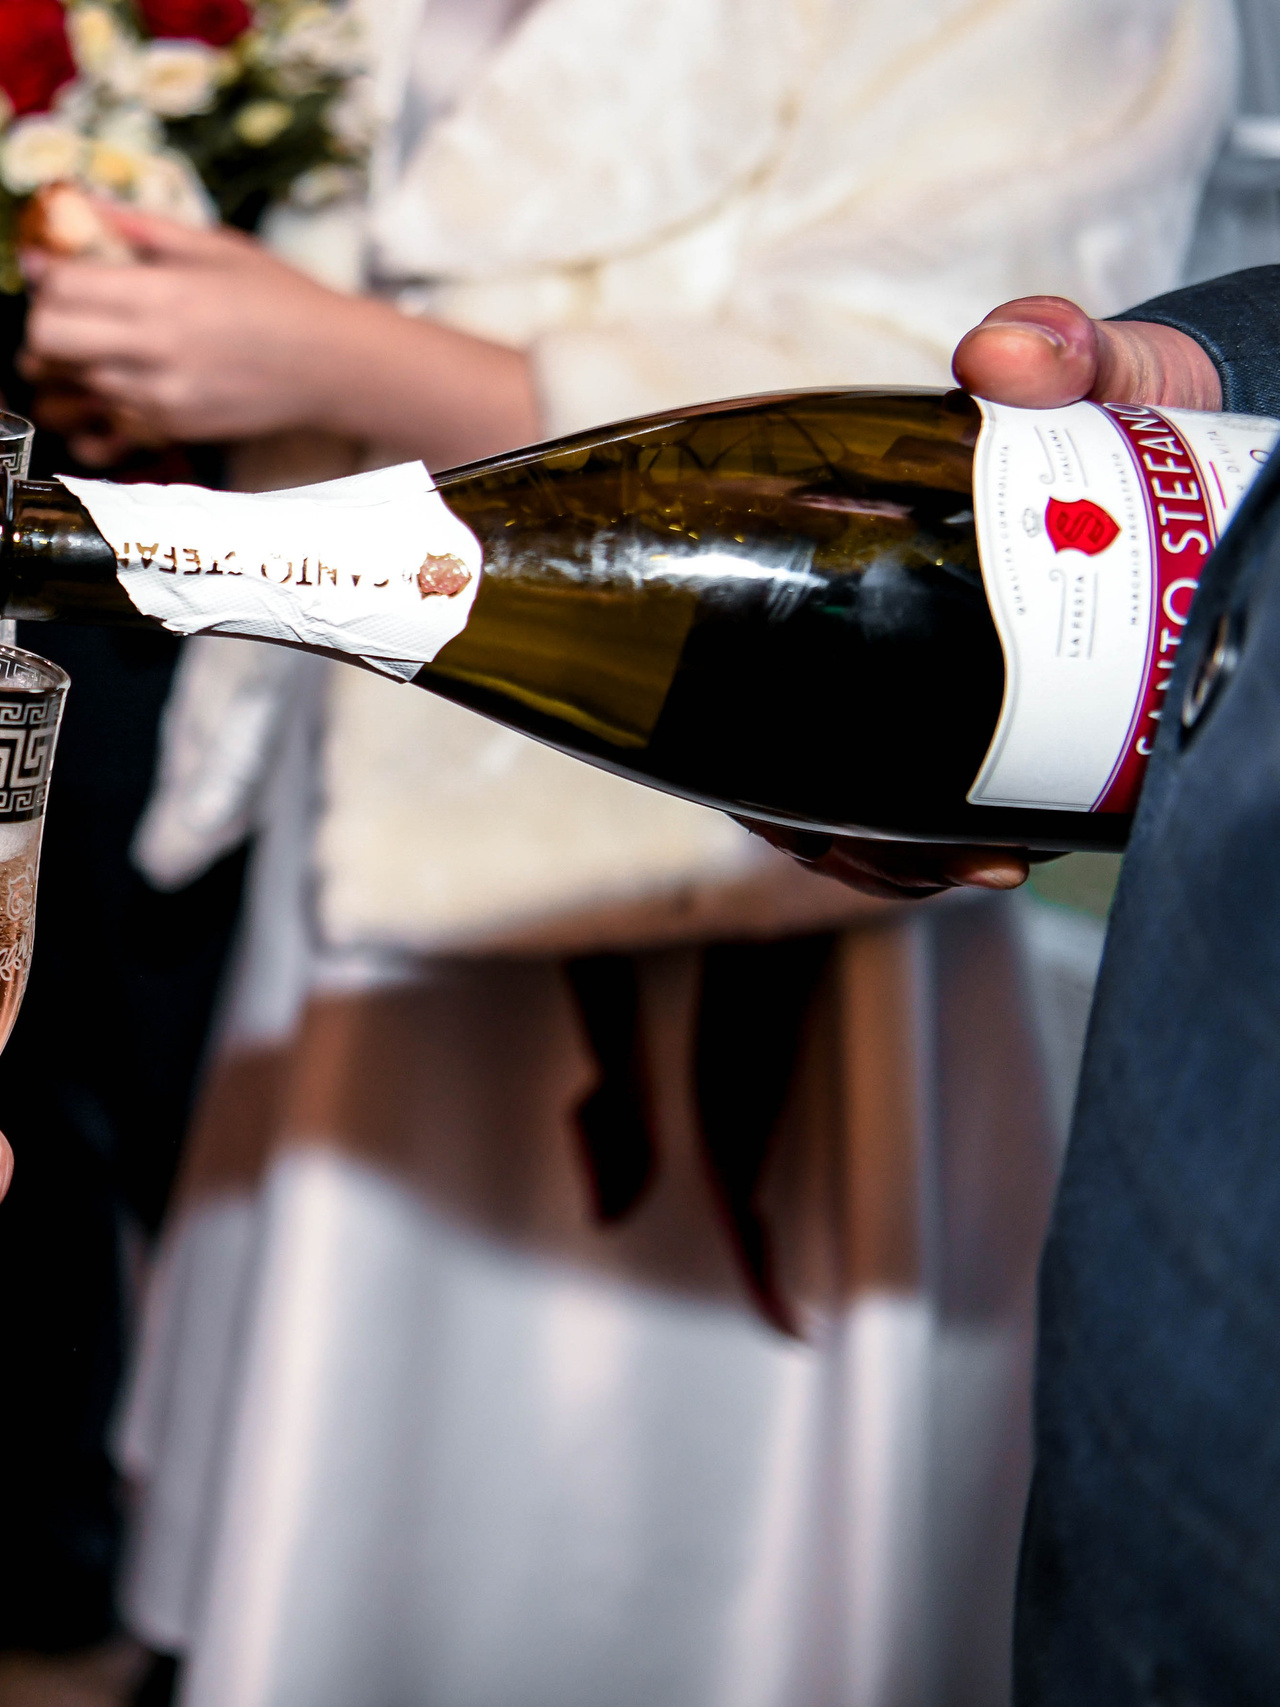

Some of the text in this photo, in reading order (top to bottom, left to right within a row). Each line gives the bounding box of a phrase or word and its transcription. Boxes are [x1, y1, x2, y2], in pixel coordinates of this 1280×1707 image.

[1047, 430, 1074, 483] ITALIANA
[1102, 402, 1210, 556] STEFANO
[1067, 576, 1085, 658] LA FESTA
